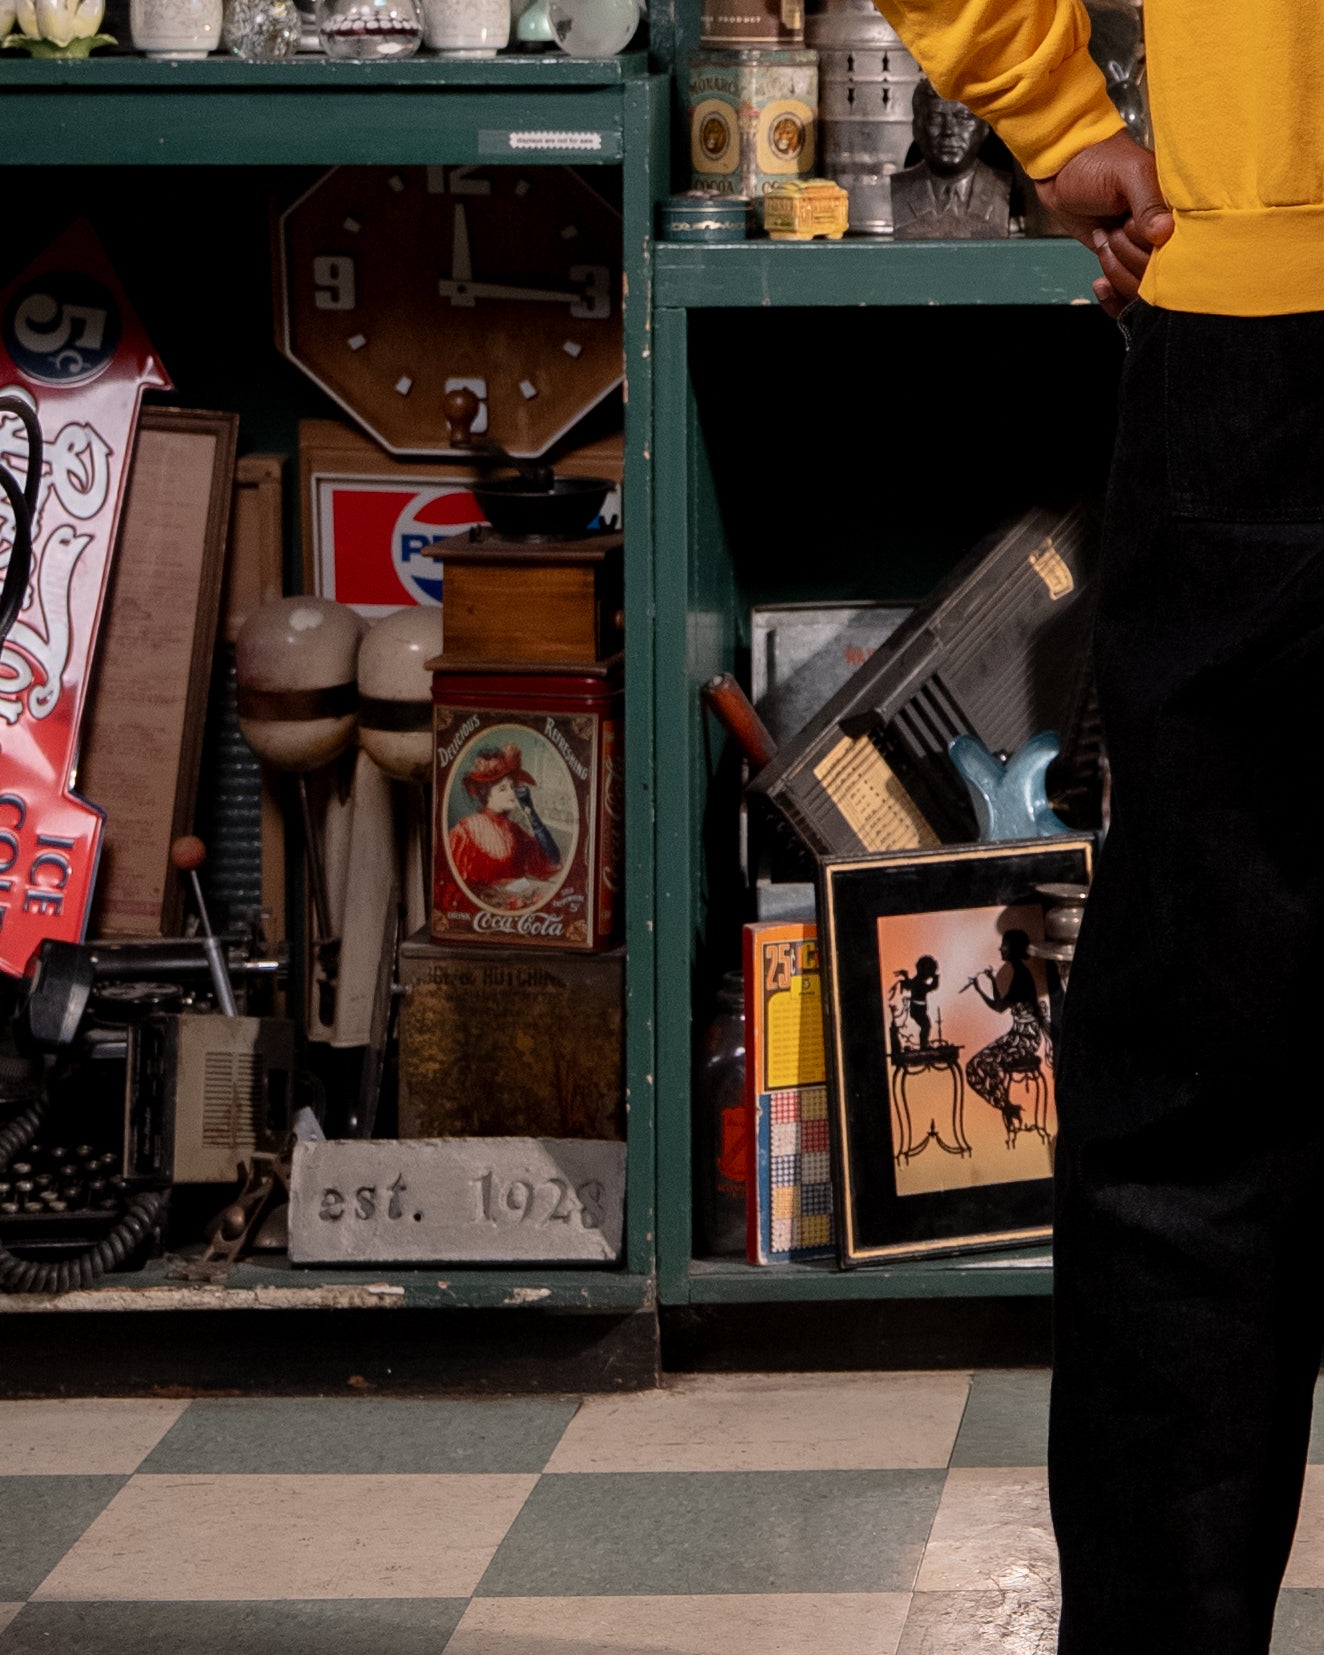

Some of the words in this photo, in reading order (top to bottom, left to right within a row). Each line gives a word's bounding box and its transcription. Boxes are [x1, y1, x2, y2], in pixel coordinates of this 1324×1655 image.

[313, 256, 356, 311] 9
[569, 264, 611, 319] 3
[437, 714, 481, 768] DELICIOUS
[544, 716, 588, 781] REFRESHING
[24, 833, 75, 917] ICE
[473, 910, 565, 937] Coca-Cola
[317, 1174, 424, 1223] est.
[471, 1169, 607, 1231] 1928
